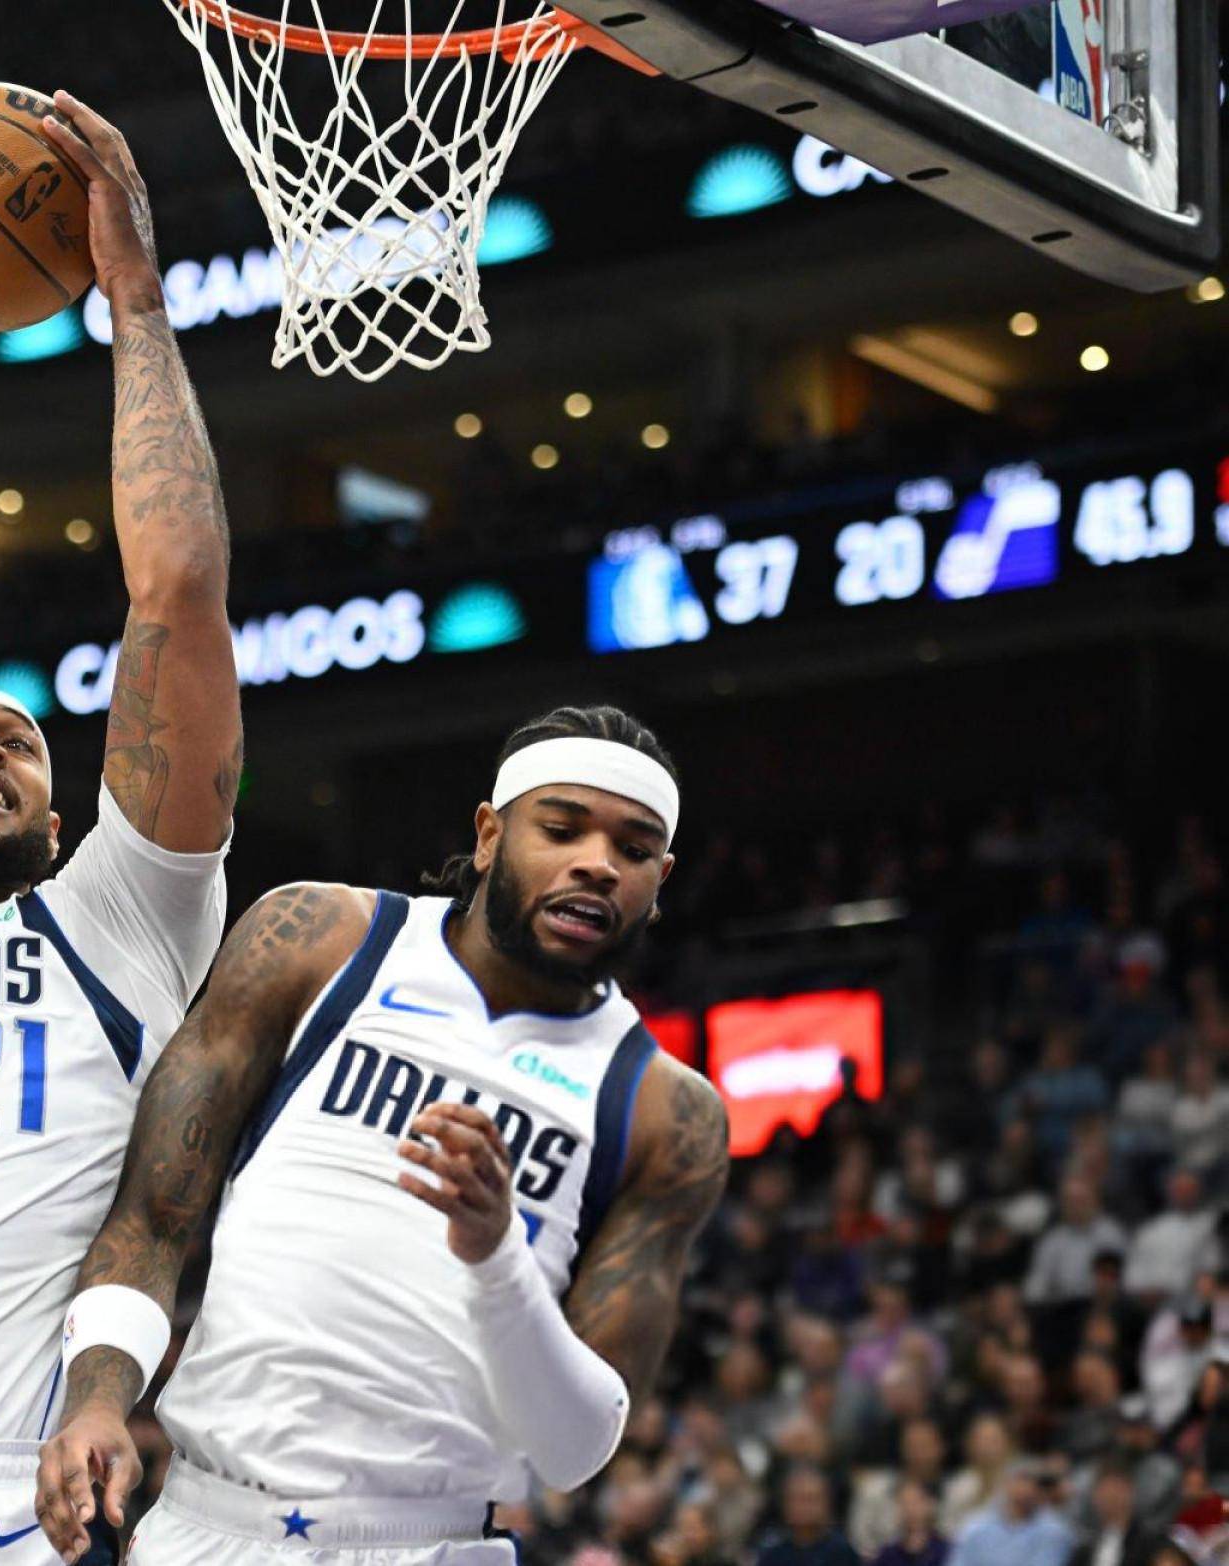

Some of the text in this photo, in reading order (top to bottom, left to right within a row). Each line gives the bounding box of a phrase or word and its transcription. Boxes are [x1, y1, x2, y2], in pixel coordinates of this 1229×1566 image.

[1060, 71, 1086, 116] NBA
[715, 536, 798, 625] 37
[834, 514, 925, 607] 20
